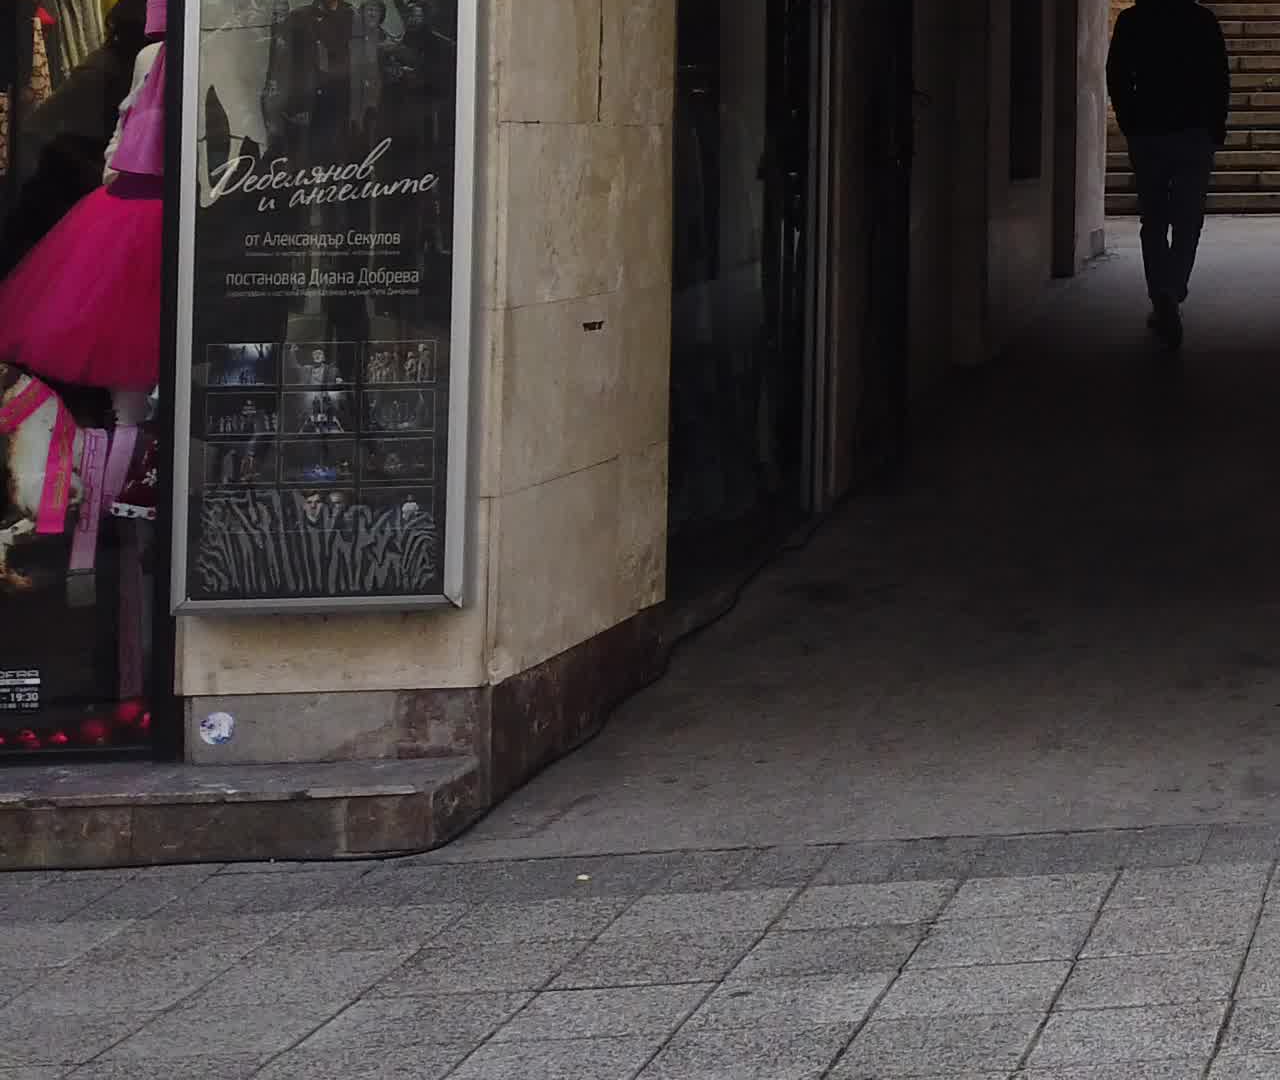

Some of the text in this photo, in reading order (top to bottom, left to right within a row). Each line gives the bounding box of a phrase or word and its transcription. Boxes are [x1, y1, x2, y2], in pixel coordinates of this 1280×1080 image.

[210, 137, 392, 198] Дебелянов
[257, 173, 439, 211] и ангелите
[245, 230, 401, 250] от Александър Секулов
[226, 267, 420, 288] постановка Диана Добрева
[10, 692, 39, 702] 19:30
